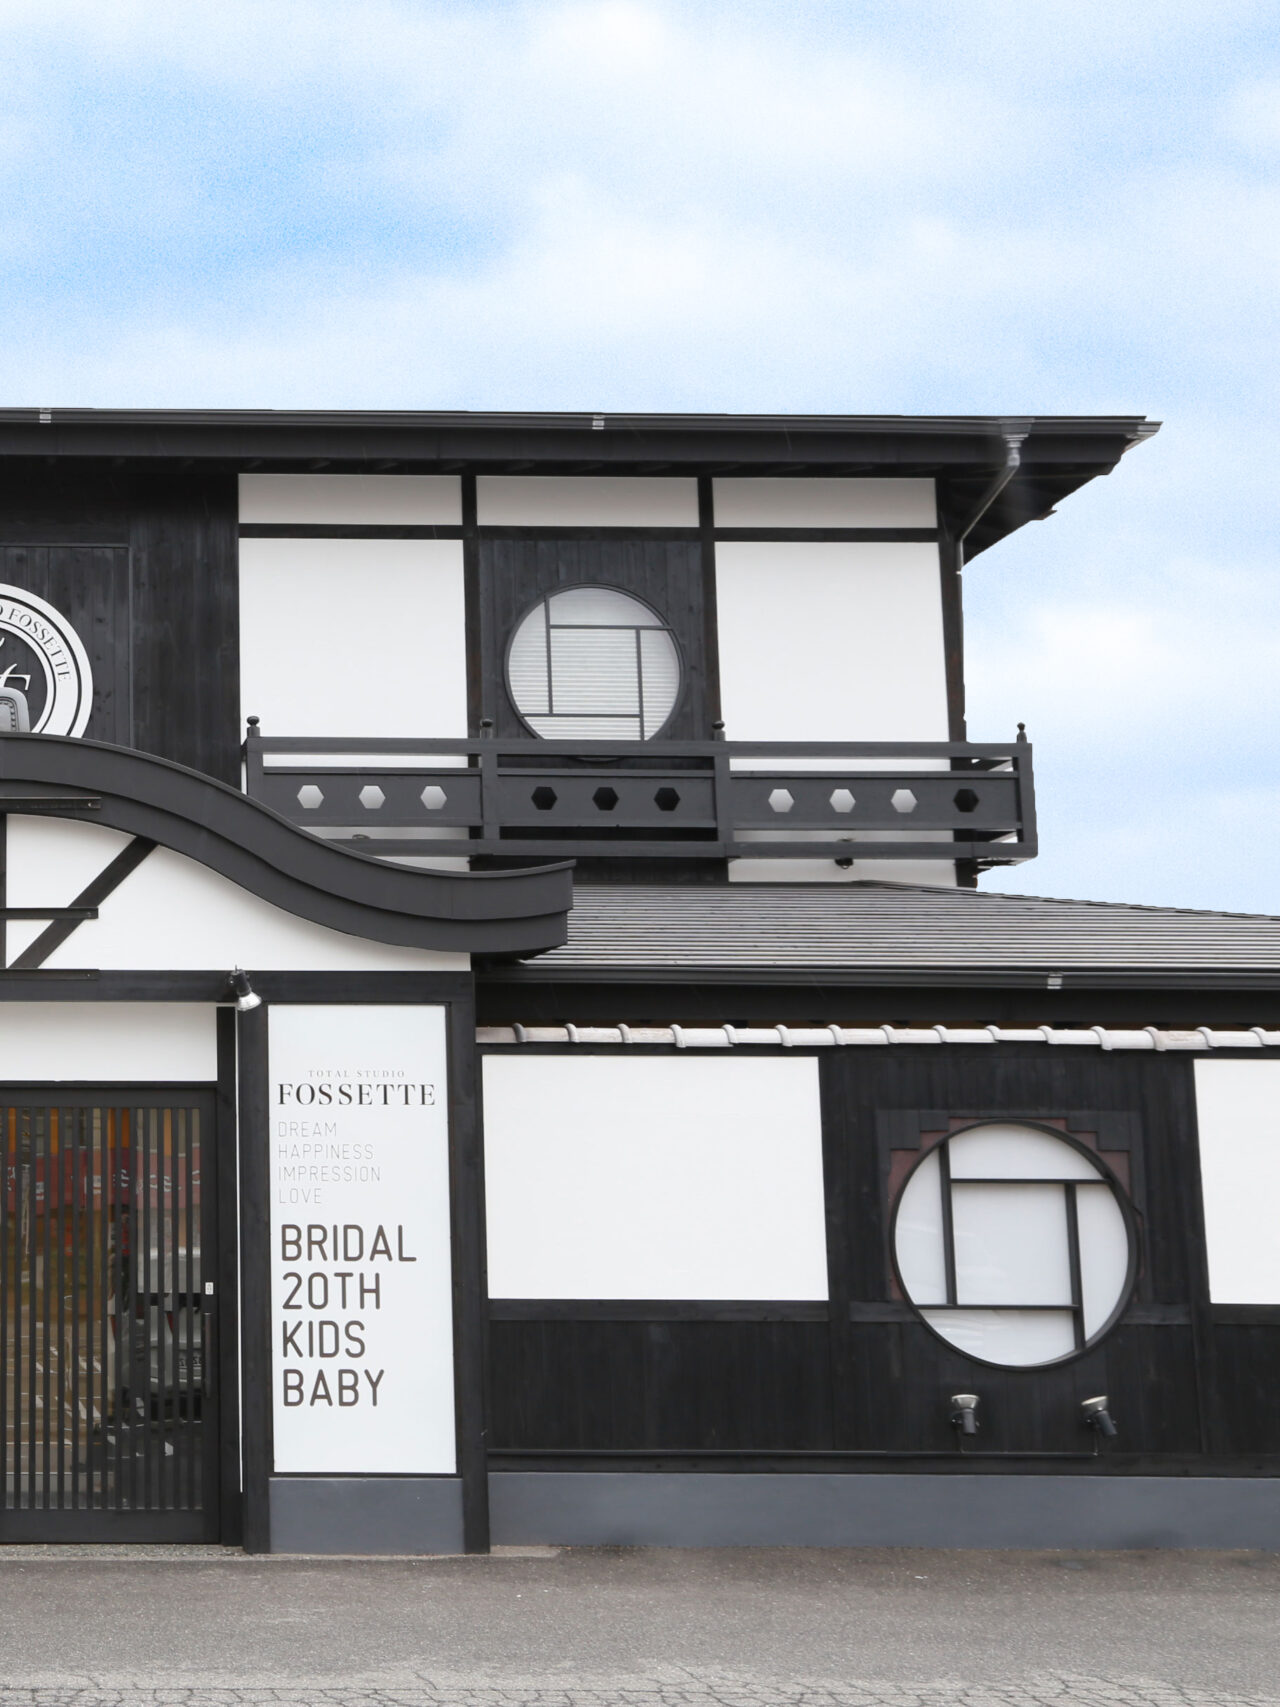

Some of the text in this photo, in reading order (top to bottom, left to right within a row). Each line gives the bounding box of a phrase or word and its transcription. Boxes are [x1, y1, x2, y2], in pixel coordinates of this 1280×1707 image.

[8, 607, 71, 682] FOSSETTE
[308, 1069, 406, 1079] TOTAL STUDIO
[278, 1084, 435, 1105] FOSSETTE
[277, 1121, 337, 1138] DREAM
[278, 1144, 374, 1160] HAPPINESS
[278, 1166, 381, 1183] IMPRESSION
[278, 1188, 322, 1204] LOVE
[281, 1224, 417, 1262] BRIDAL
[282, 1272, 380, 1310] 20TH
[282, 1320, 365, 1358] KIDS
[283, 1369, 384, 1407] BABY
